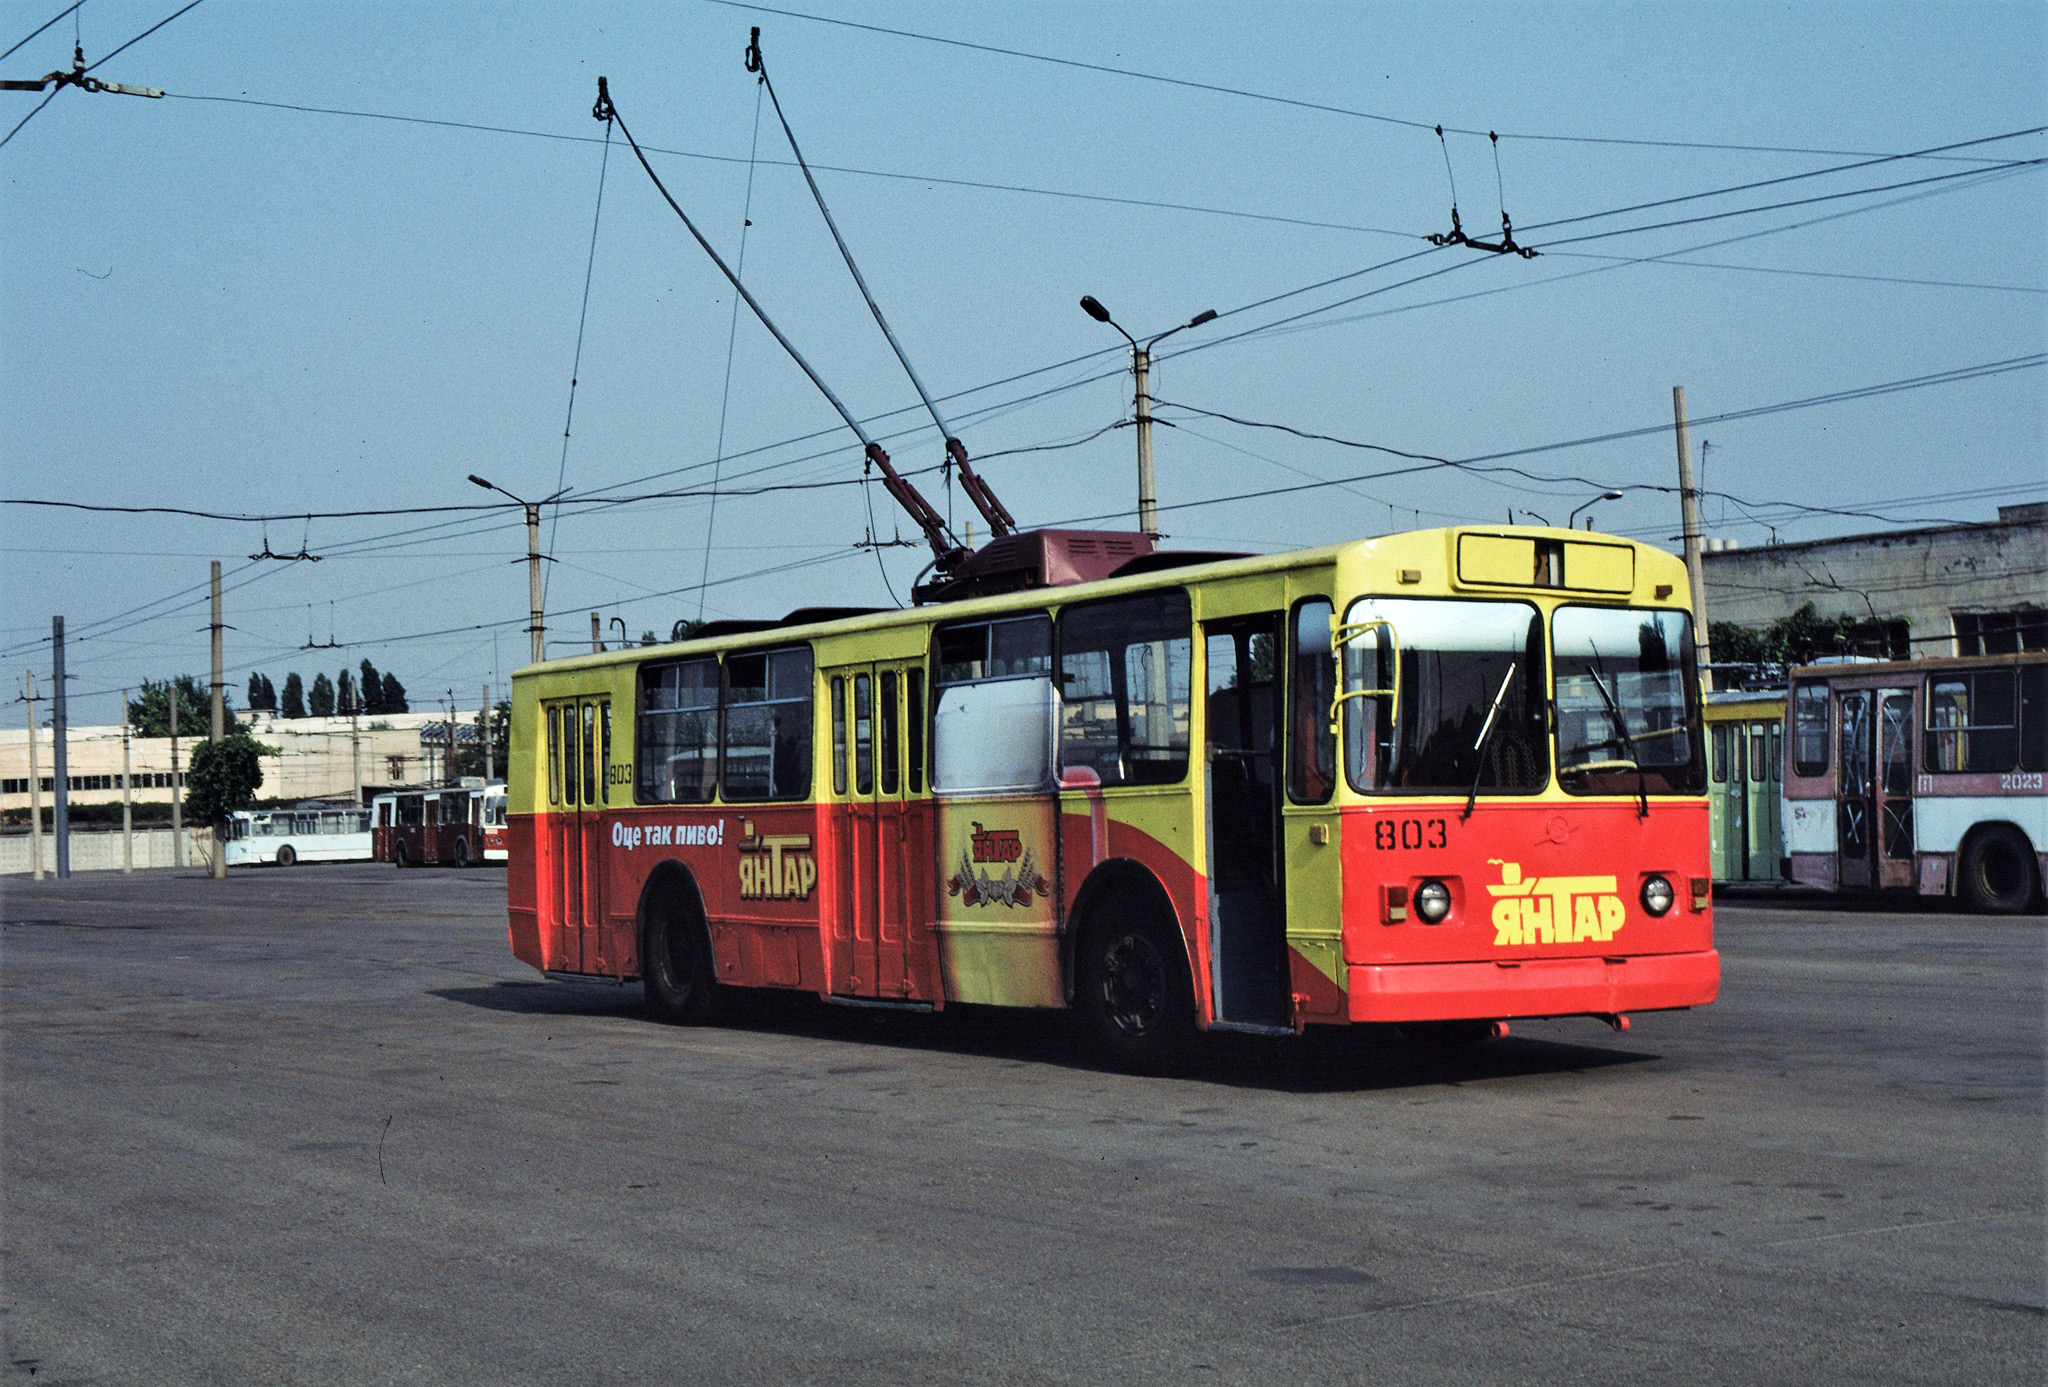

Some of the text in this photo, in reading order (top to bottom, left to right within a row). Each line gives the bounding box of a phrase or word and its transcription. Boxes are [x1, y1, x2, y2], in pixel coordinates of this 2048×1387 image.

[610, 764, 632, 785] 803
[2001, 774, 2042, 790] 2023
[612, 819, 724, 851] Оце так пиво!
[972, 829, 1022, 863] ЯНТАР
[1375, 819, 1447, 850] 803
[738, 834, 818, 900] ЯНТАР
[1491, 875, 1626, 946] ЯНТАР
